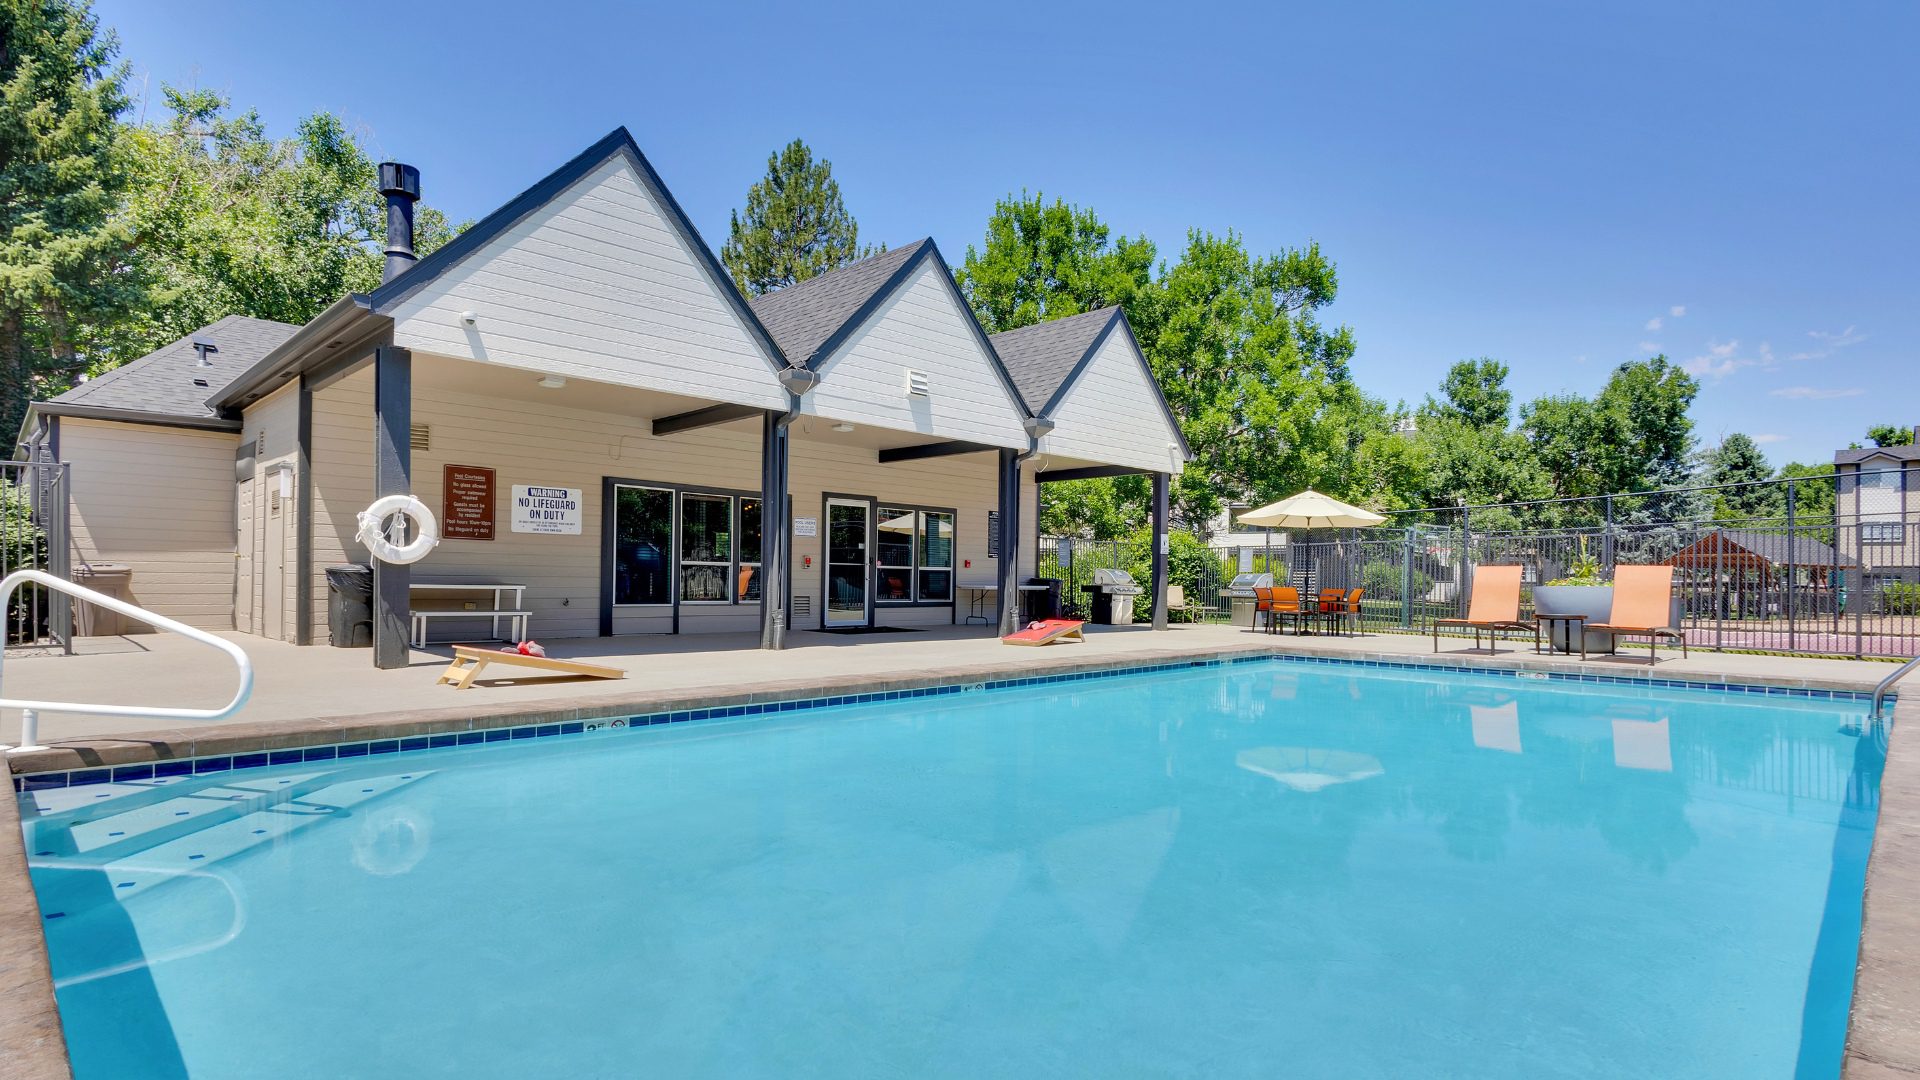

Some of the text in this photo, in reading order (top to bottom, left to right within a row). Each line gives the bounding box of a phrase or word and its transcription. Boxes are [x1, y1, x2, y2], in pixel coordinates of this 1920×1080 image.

[530, 488, 566, 499] WARNING
[518, 497, 576, 510] NO LIFEGUARD
[529, 509, 565, 520] ON DUTY
